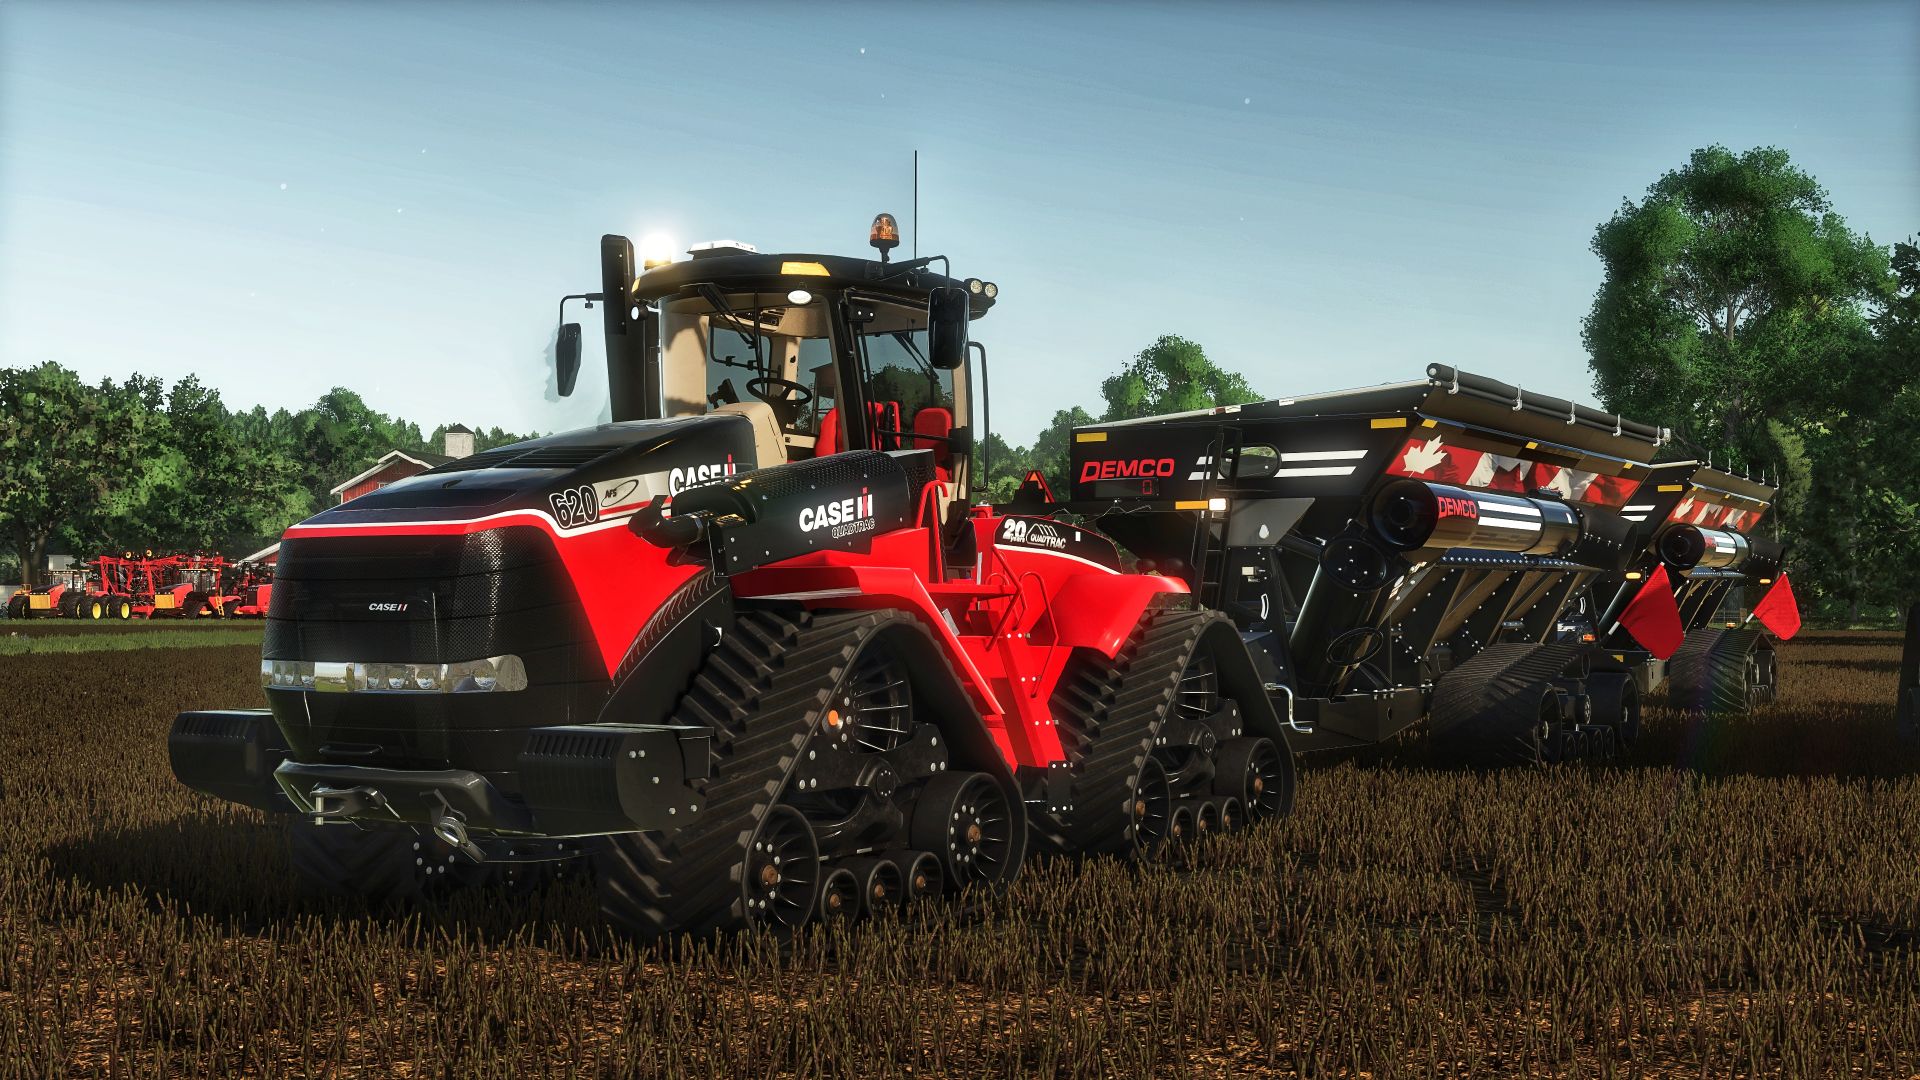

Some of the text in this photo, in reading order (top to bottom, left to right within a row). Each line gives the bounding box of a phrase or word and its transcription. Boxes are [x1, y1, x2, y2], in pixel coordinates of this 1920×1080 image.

[669, 464, 722, 498] CASE
[1080, 458, 1175, 484] DEMCO
[1142, 479, 1153, 495] 0
[549, 484, 599, 529] 620
[799, 498, 855, 532] CASE
[1437, 496, 1478, 519] DEMCO
[832, 517, 876, 539] QUADTRAC
[1002, 518, 1027, 540] 20
[1030, 533, 1066, 549] QUADTRAC
[368, 602, 398, 612] CASE
